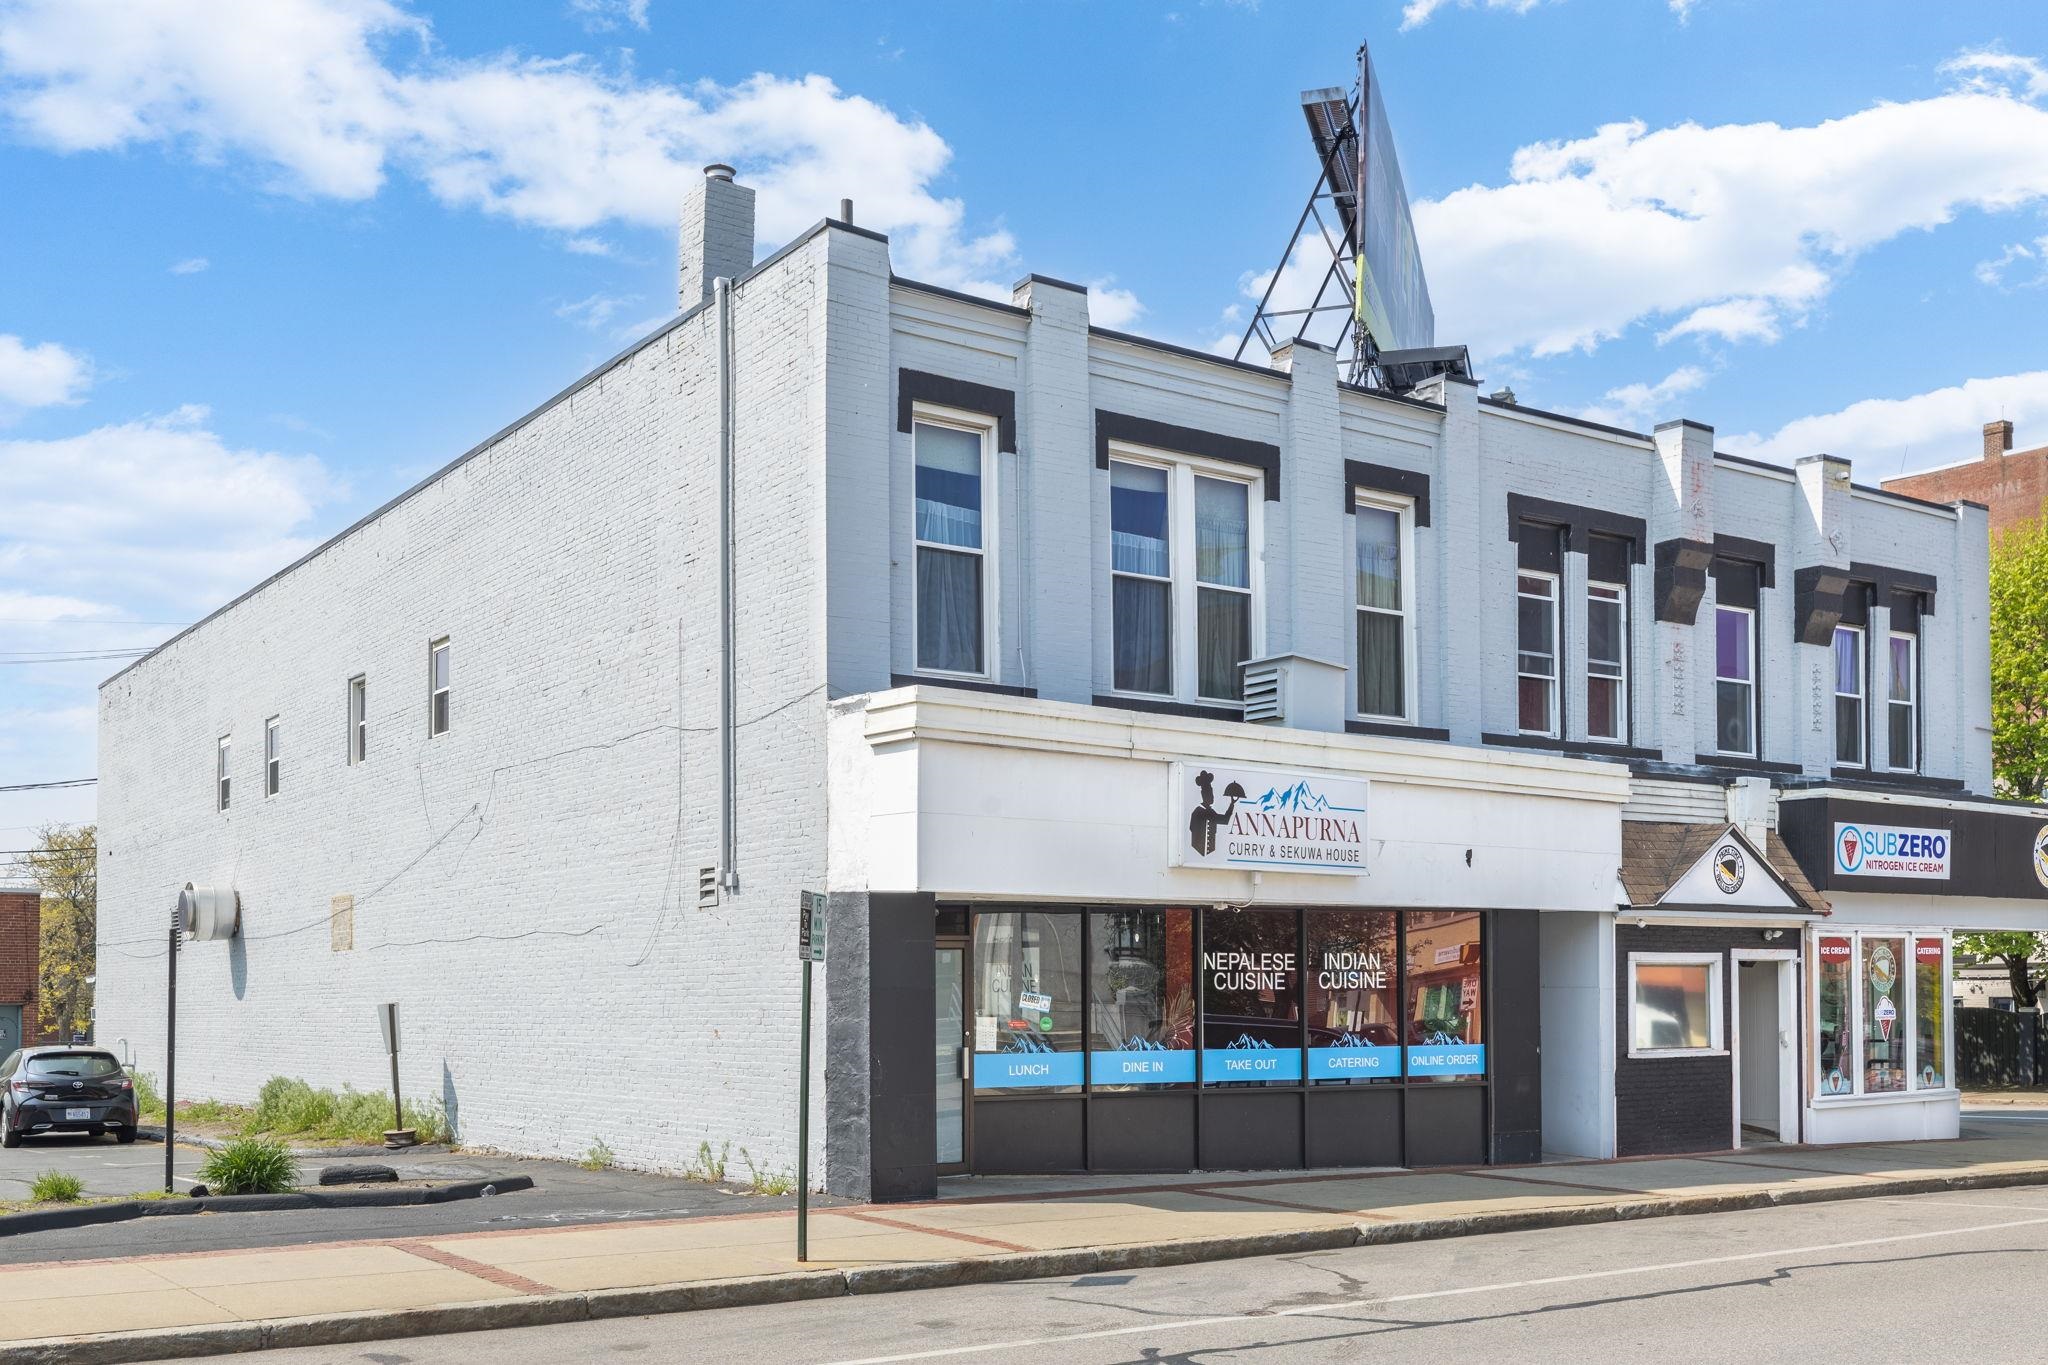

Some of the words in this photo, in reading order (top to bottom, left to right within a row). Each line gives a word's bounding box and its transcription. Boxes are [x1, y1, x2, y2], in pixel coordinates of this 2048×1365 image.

[1228, 812, 1361, 843] ANNAPURNA
[1864, 831, 1946, 859] SUBZERO
[1229, 842, 1265, 857] CURRY
[1270, 844, 1275, 858] &
[1280, 845, 1321, 860] SEKUWA
[1326, 848, 1360, 862] HOUSE
[1865, 860, 1904, 871] NITROGEN
[1905, 862, 1917, 872] ICE
[1919, 863, 1944, 873] CREAM
[1820, 946, 1831, 955] ICE
[1831, 947, 1851, 955] CREAM
[1917, 947, 1941, 955] CATERING
[1203, 952, 1295, 971] NEPALESE
[1324, 952, 1380, 970] INDIAN
[1213, 972, 1286, 990] CUISINE
[1318, 971, 1387, 989] CUISINE
[1225, 1059, 1252, 1070] TAKE
[1254, 1059, 1277, 1070] OUT
[1328, 1057, 1380, 1068] CATERING
[1411, 1055, 1445, 1066] ONLINE
[1447, 1054, 1479, 1065] ORDER
[1009, 1064, 1049, 1077] LUNCH
[1122, 1062, 1149, 1073] DINE
[1152, 1061, 1164, 1072] IN
